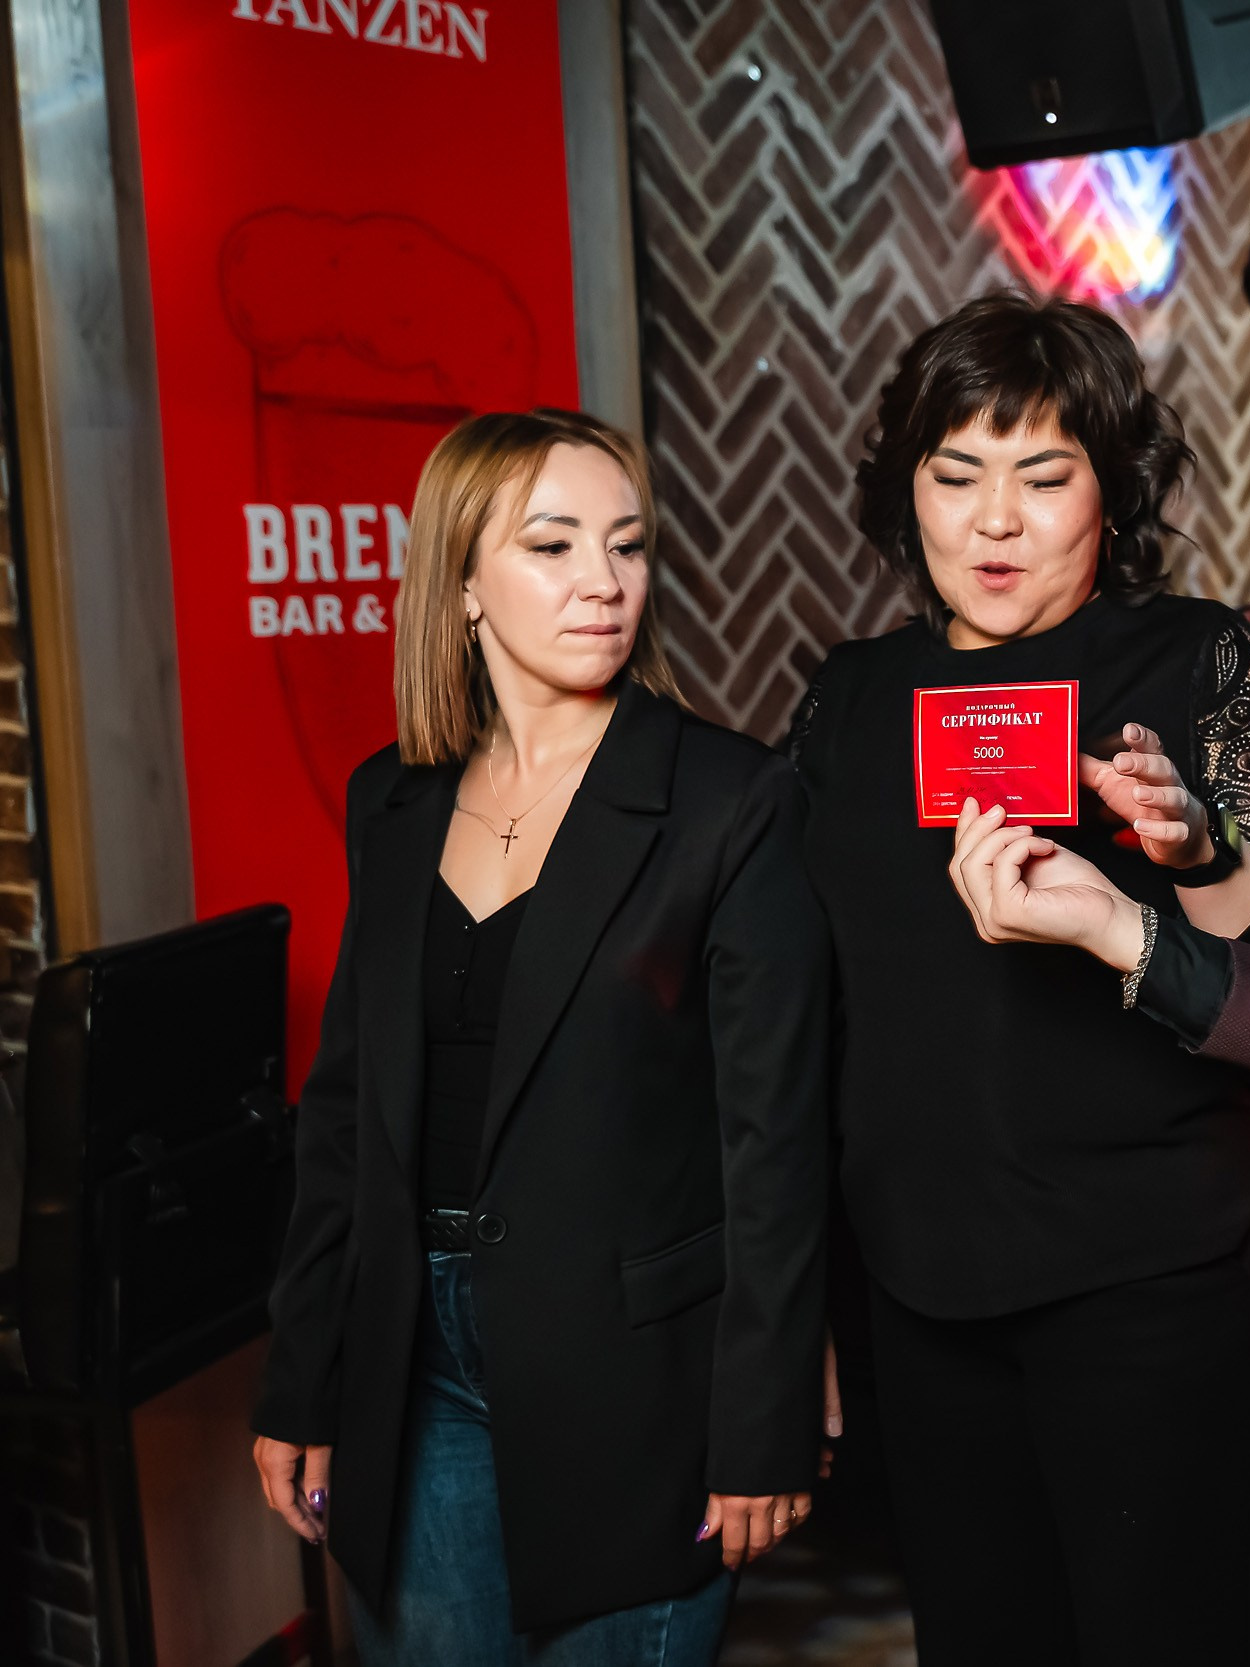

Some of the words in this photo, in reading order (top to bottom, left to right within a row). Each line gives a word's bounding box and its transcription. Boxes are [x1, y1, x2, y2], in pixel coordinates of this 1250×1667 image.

[250, 595, 345, 637] BAR
[352, 593, 389, 633] &
[965, 702, 1016, 711] ПОДАРОЧНЫЙ
[941, 711, 1043, 728] СЕРТИФИКАТ
[973, 746, 1005, 759] 5000
